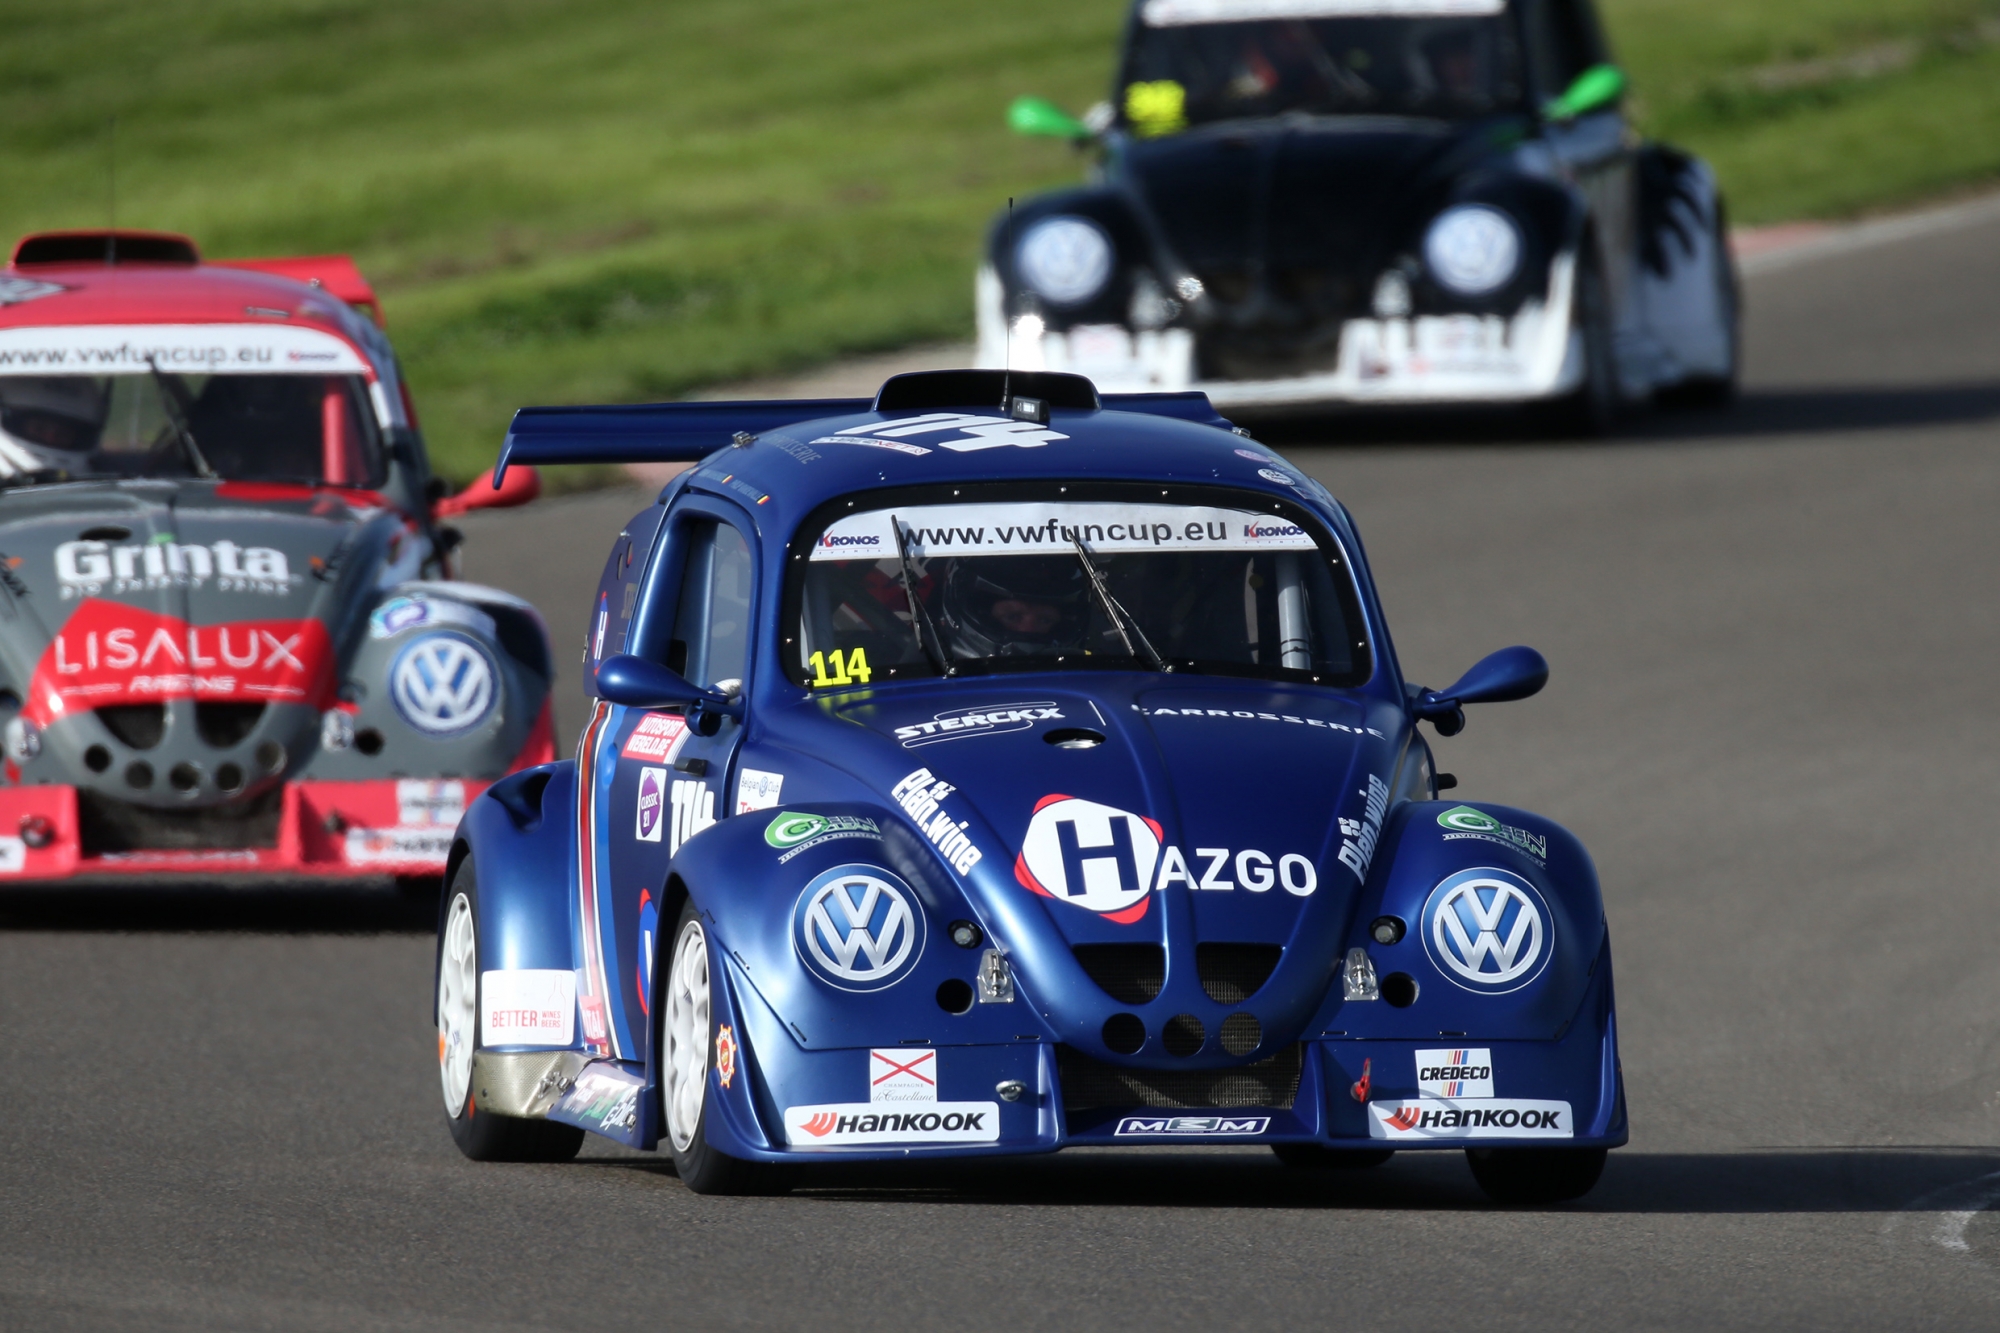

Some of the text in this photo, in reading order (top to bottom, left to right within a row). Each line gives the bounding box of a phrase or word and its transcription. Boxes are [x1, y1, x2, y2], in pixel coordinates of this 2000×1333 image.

[818, 530, 880, 548] KRONOS
[901, 518, 1228, 546] www.vwfuncup.eu
[1243, 521, 1305, 538] KRONOS
[54, 540, 290, 581] Grinta
[54, 627, 304, 674] LISALUX
[808, 647, 871, 687] 114
[636, 716, 685, 738] AUTOSPORT
[894, 707, 1066, 740] STERCKX
[640, 792, 659, 810] CLASSIC
[492, 1009, 561, 1028] BETTER WINES
[541, 1019, 561, 1028] BEERS
[1420, 1066, 1491, 1081] CREDECO
